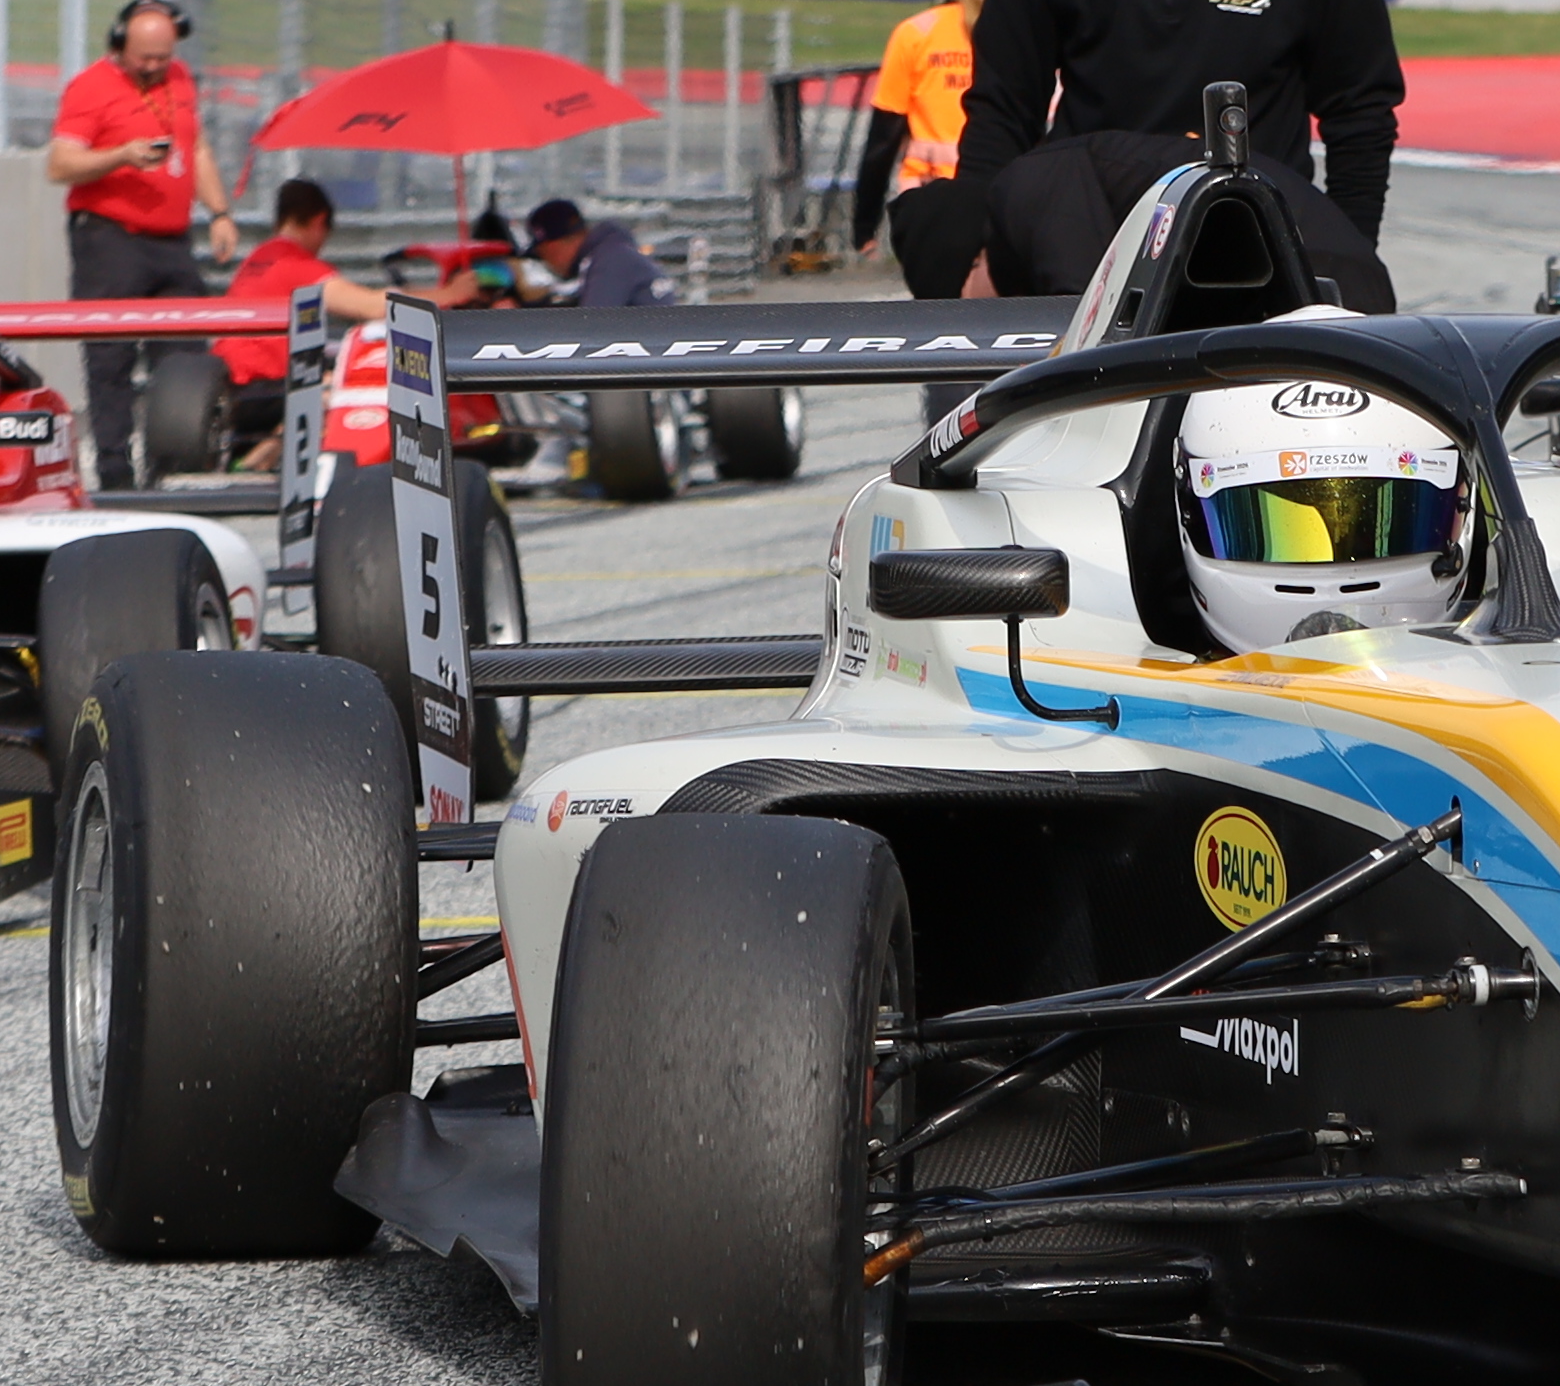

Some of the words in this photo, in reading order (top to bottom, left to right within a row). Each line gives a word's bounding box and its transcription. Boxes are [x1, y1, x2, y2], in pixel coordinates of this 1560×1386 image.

[472, 334, 1058, 361] MAFFIRAC
[1289, 384, 1359, 407] Arai
[1309, 452, 1369, 465] rzeszów
[421, 532, 441, 640] 5
[1221, 840, 1275, 906] RAUCH
